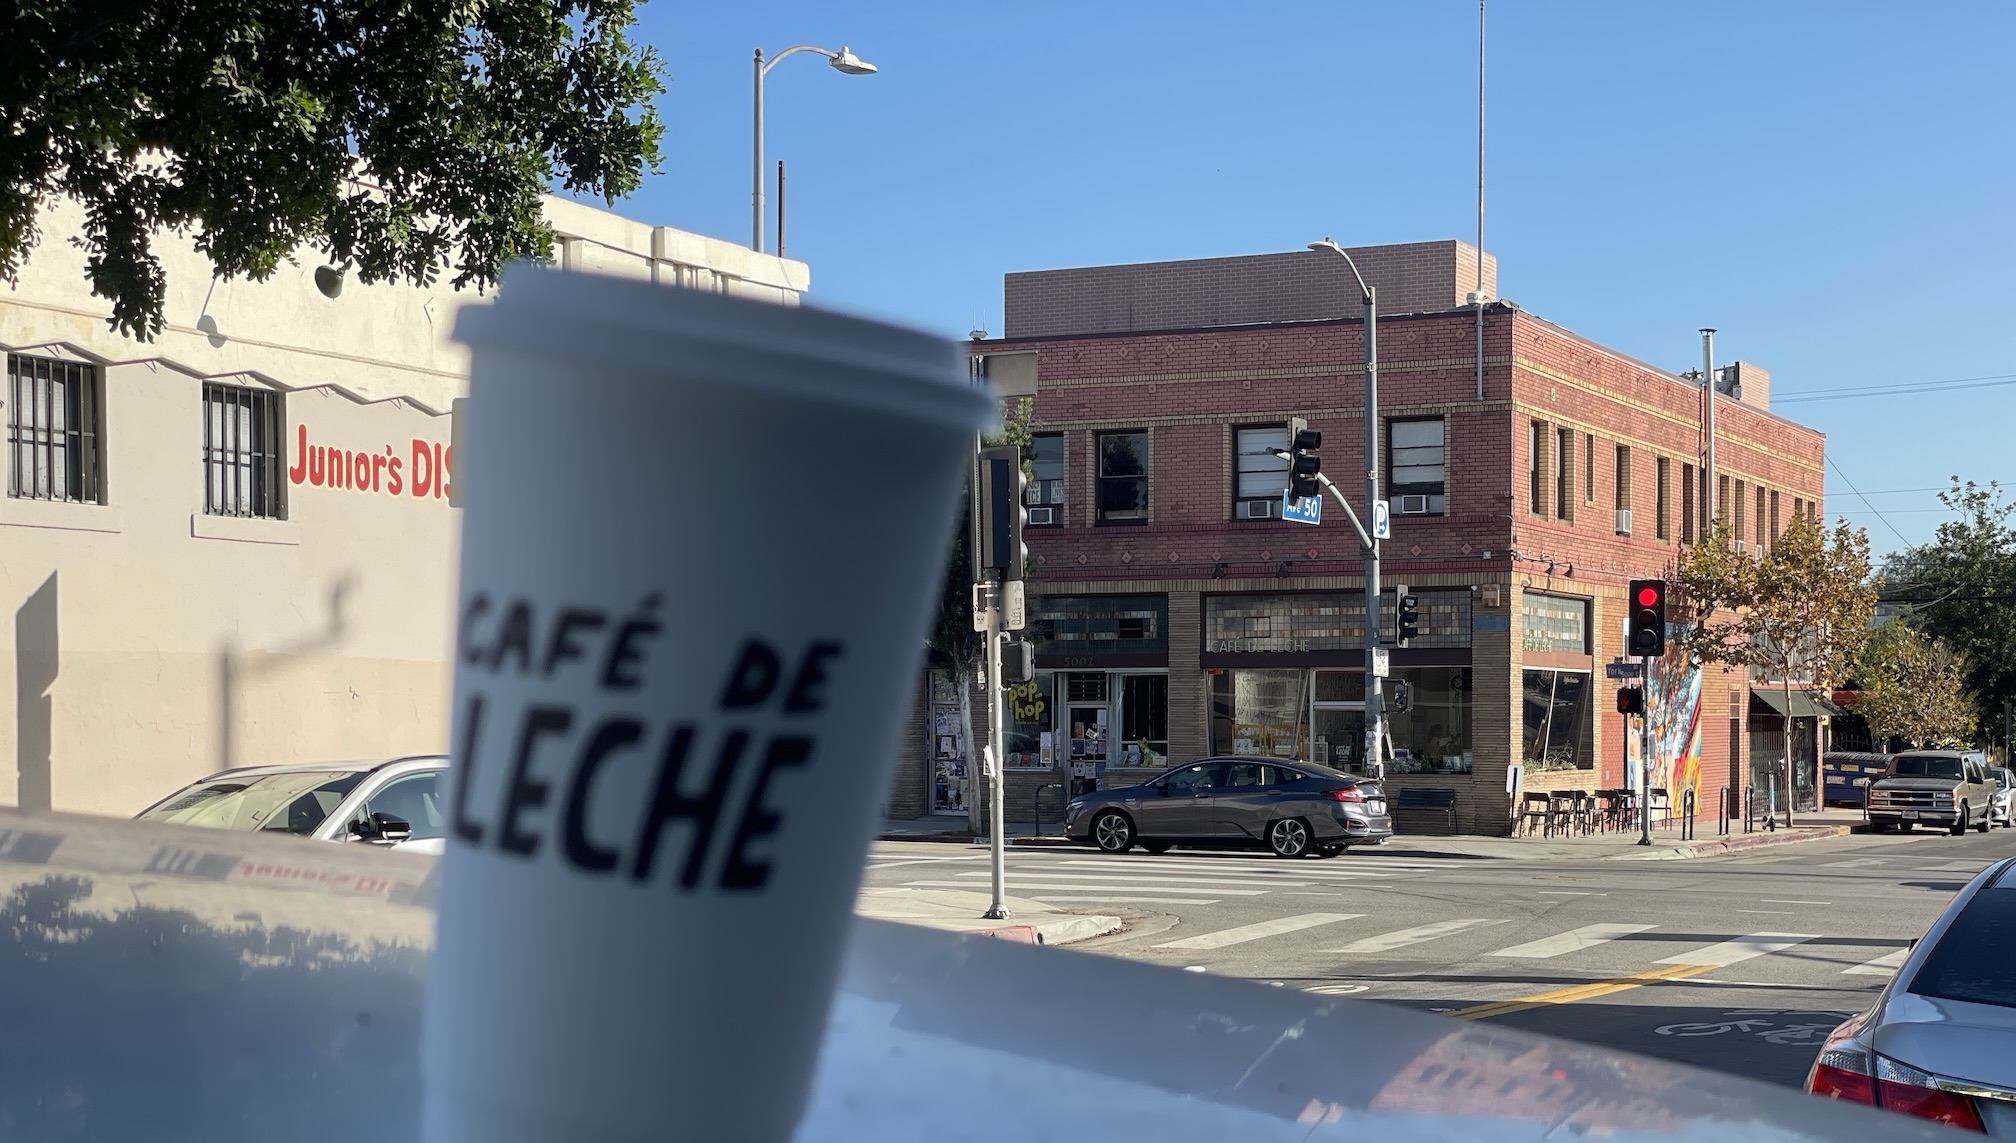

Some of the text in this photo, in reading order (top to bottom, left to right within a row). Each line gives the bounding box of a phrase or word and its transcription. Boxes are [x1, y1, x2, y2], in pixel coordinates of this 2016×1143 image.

[289, 424, 403, 496] Junior's
[1304, 499, 1318, 518] 50
[459, 591, 847, 714] CAFÉ DE
[1210, 637, 1241, 653] CAFÉ
[1064, 657, 1095, 667] 5002
[1014, 701, 1045, 720] hop
[450, 692, 815, 893] LECHE
